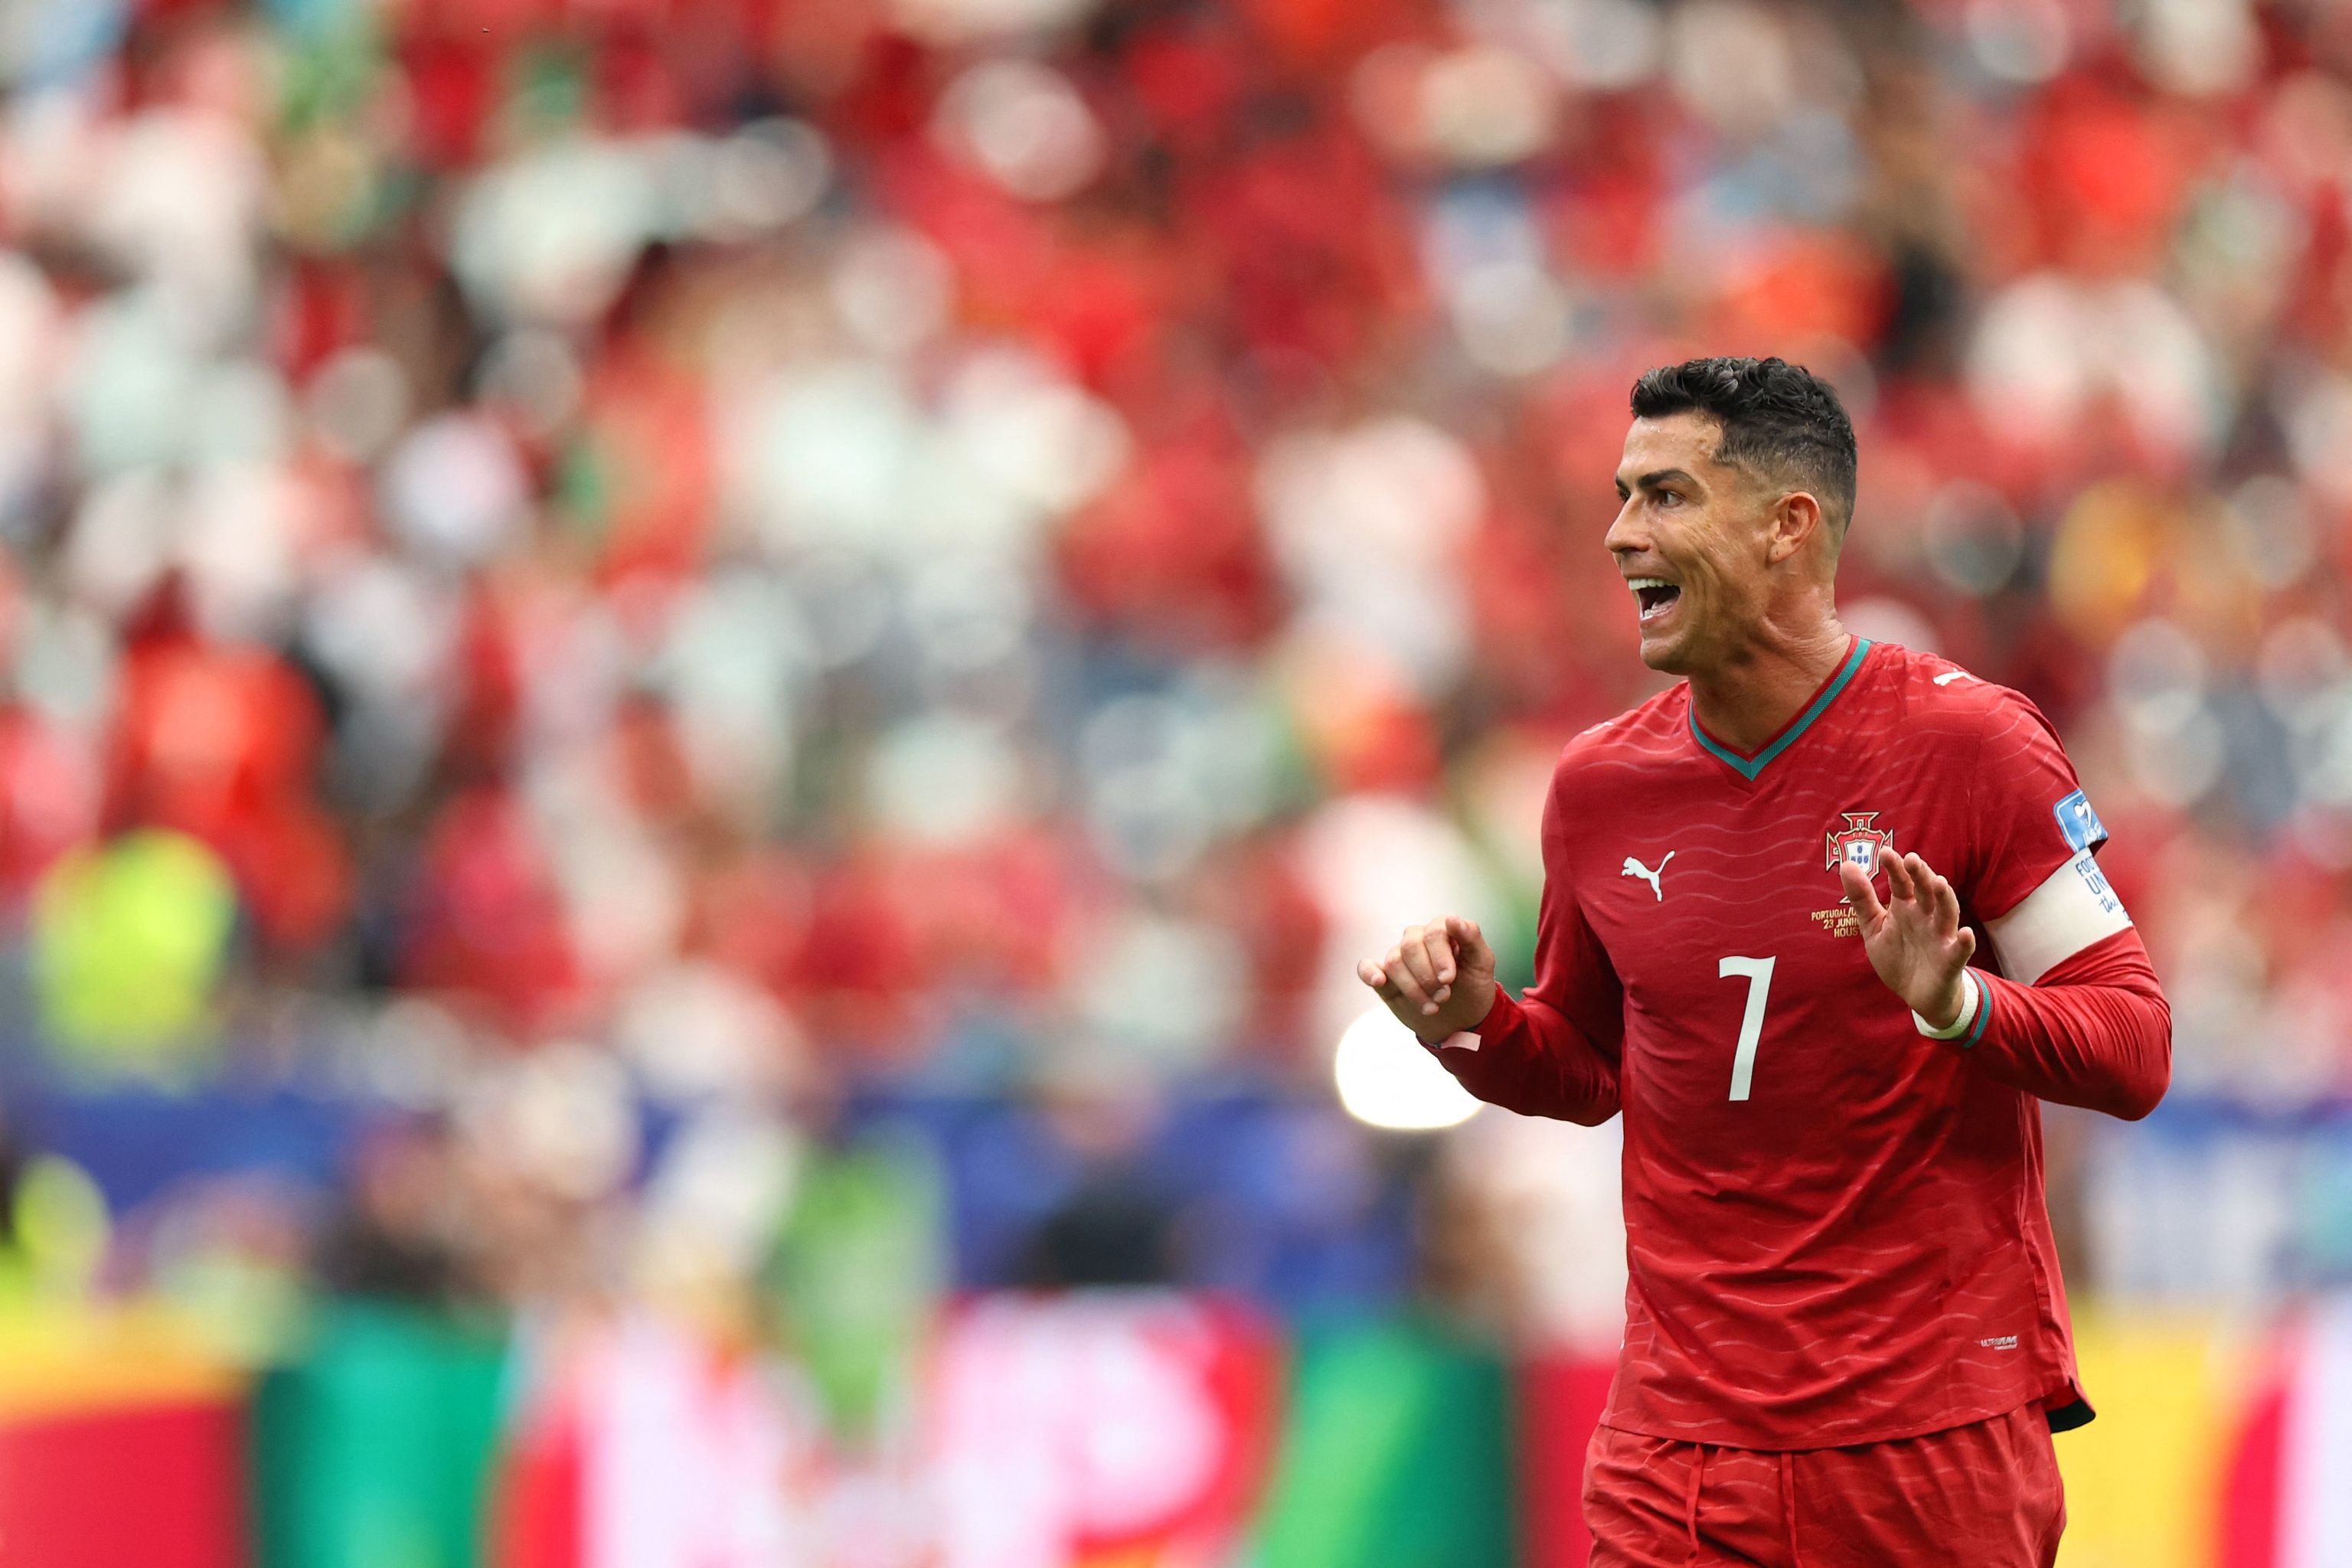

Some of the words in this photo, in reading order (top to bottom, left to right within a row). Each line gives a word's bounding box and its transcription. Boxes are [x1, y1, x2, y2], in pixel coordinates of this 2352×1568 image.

[2086, 871, 2109, 895] UN
[1811, 906, 1857, 921] PORTUGAL/U
[1823, 919, 1834, 929] 23
[1836, 917, 1858, 928] JUNH
[1719, 956, 1776, 1102] 7
